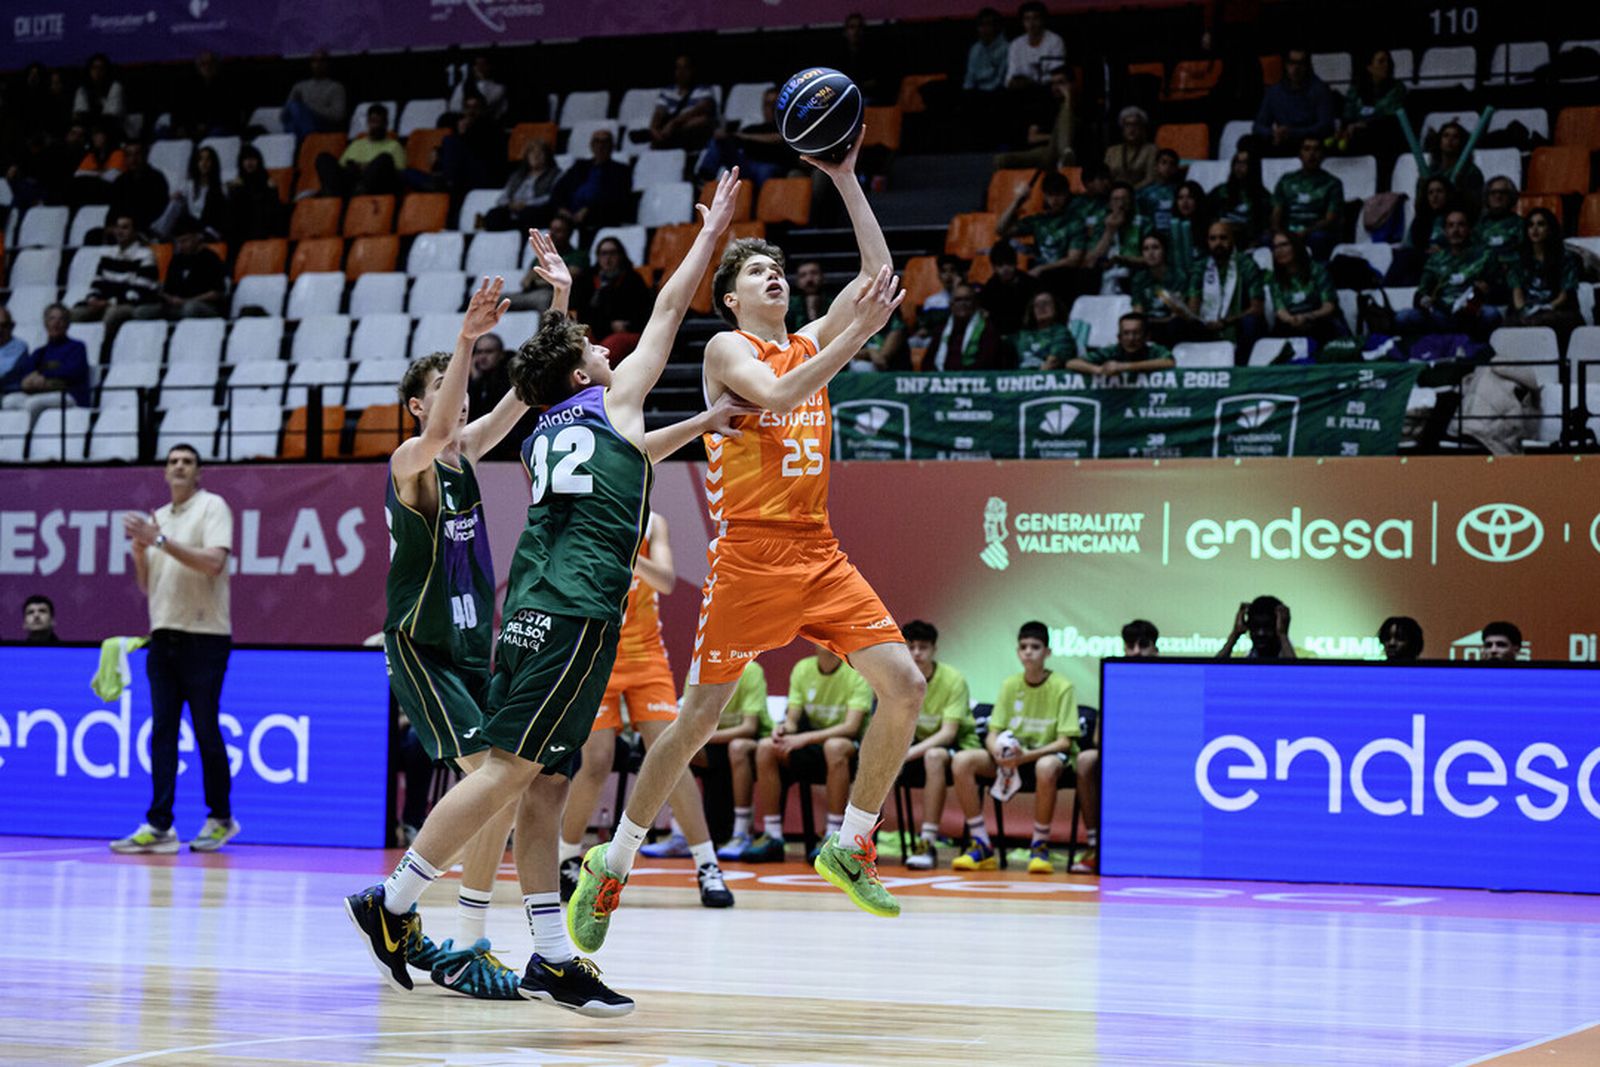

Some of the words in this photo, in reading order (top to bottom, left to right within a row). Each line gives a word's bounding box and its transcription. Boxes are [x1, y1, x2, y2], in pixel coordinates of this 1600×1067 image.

[1429, 8, 1478, 34] 110
[895, 377, 992, 394] INFANTIL
[996, 373, 1087, 392] UNICAJA
[530, 434, 595, 504] 32
[781, 438, 824, 477] 25
[1015, 513, 1145, 532] GENERALITAT
[1186, 507, 1413, 560] endesa
[0, 508, 366, 576] ESTRLAS
[1016, 534, 1141, 553] VALENCIANA
[450, 593, 478, 630] 40
[1048, 626, 1126, 657] ilson
[0, 688, 310, 784] ndesa
